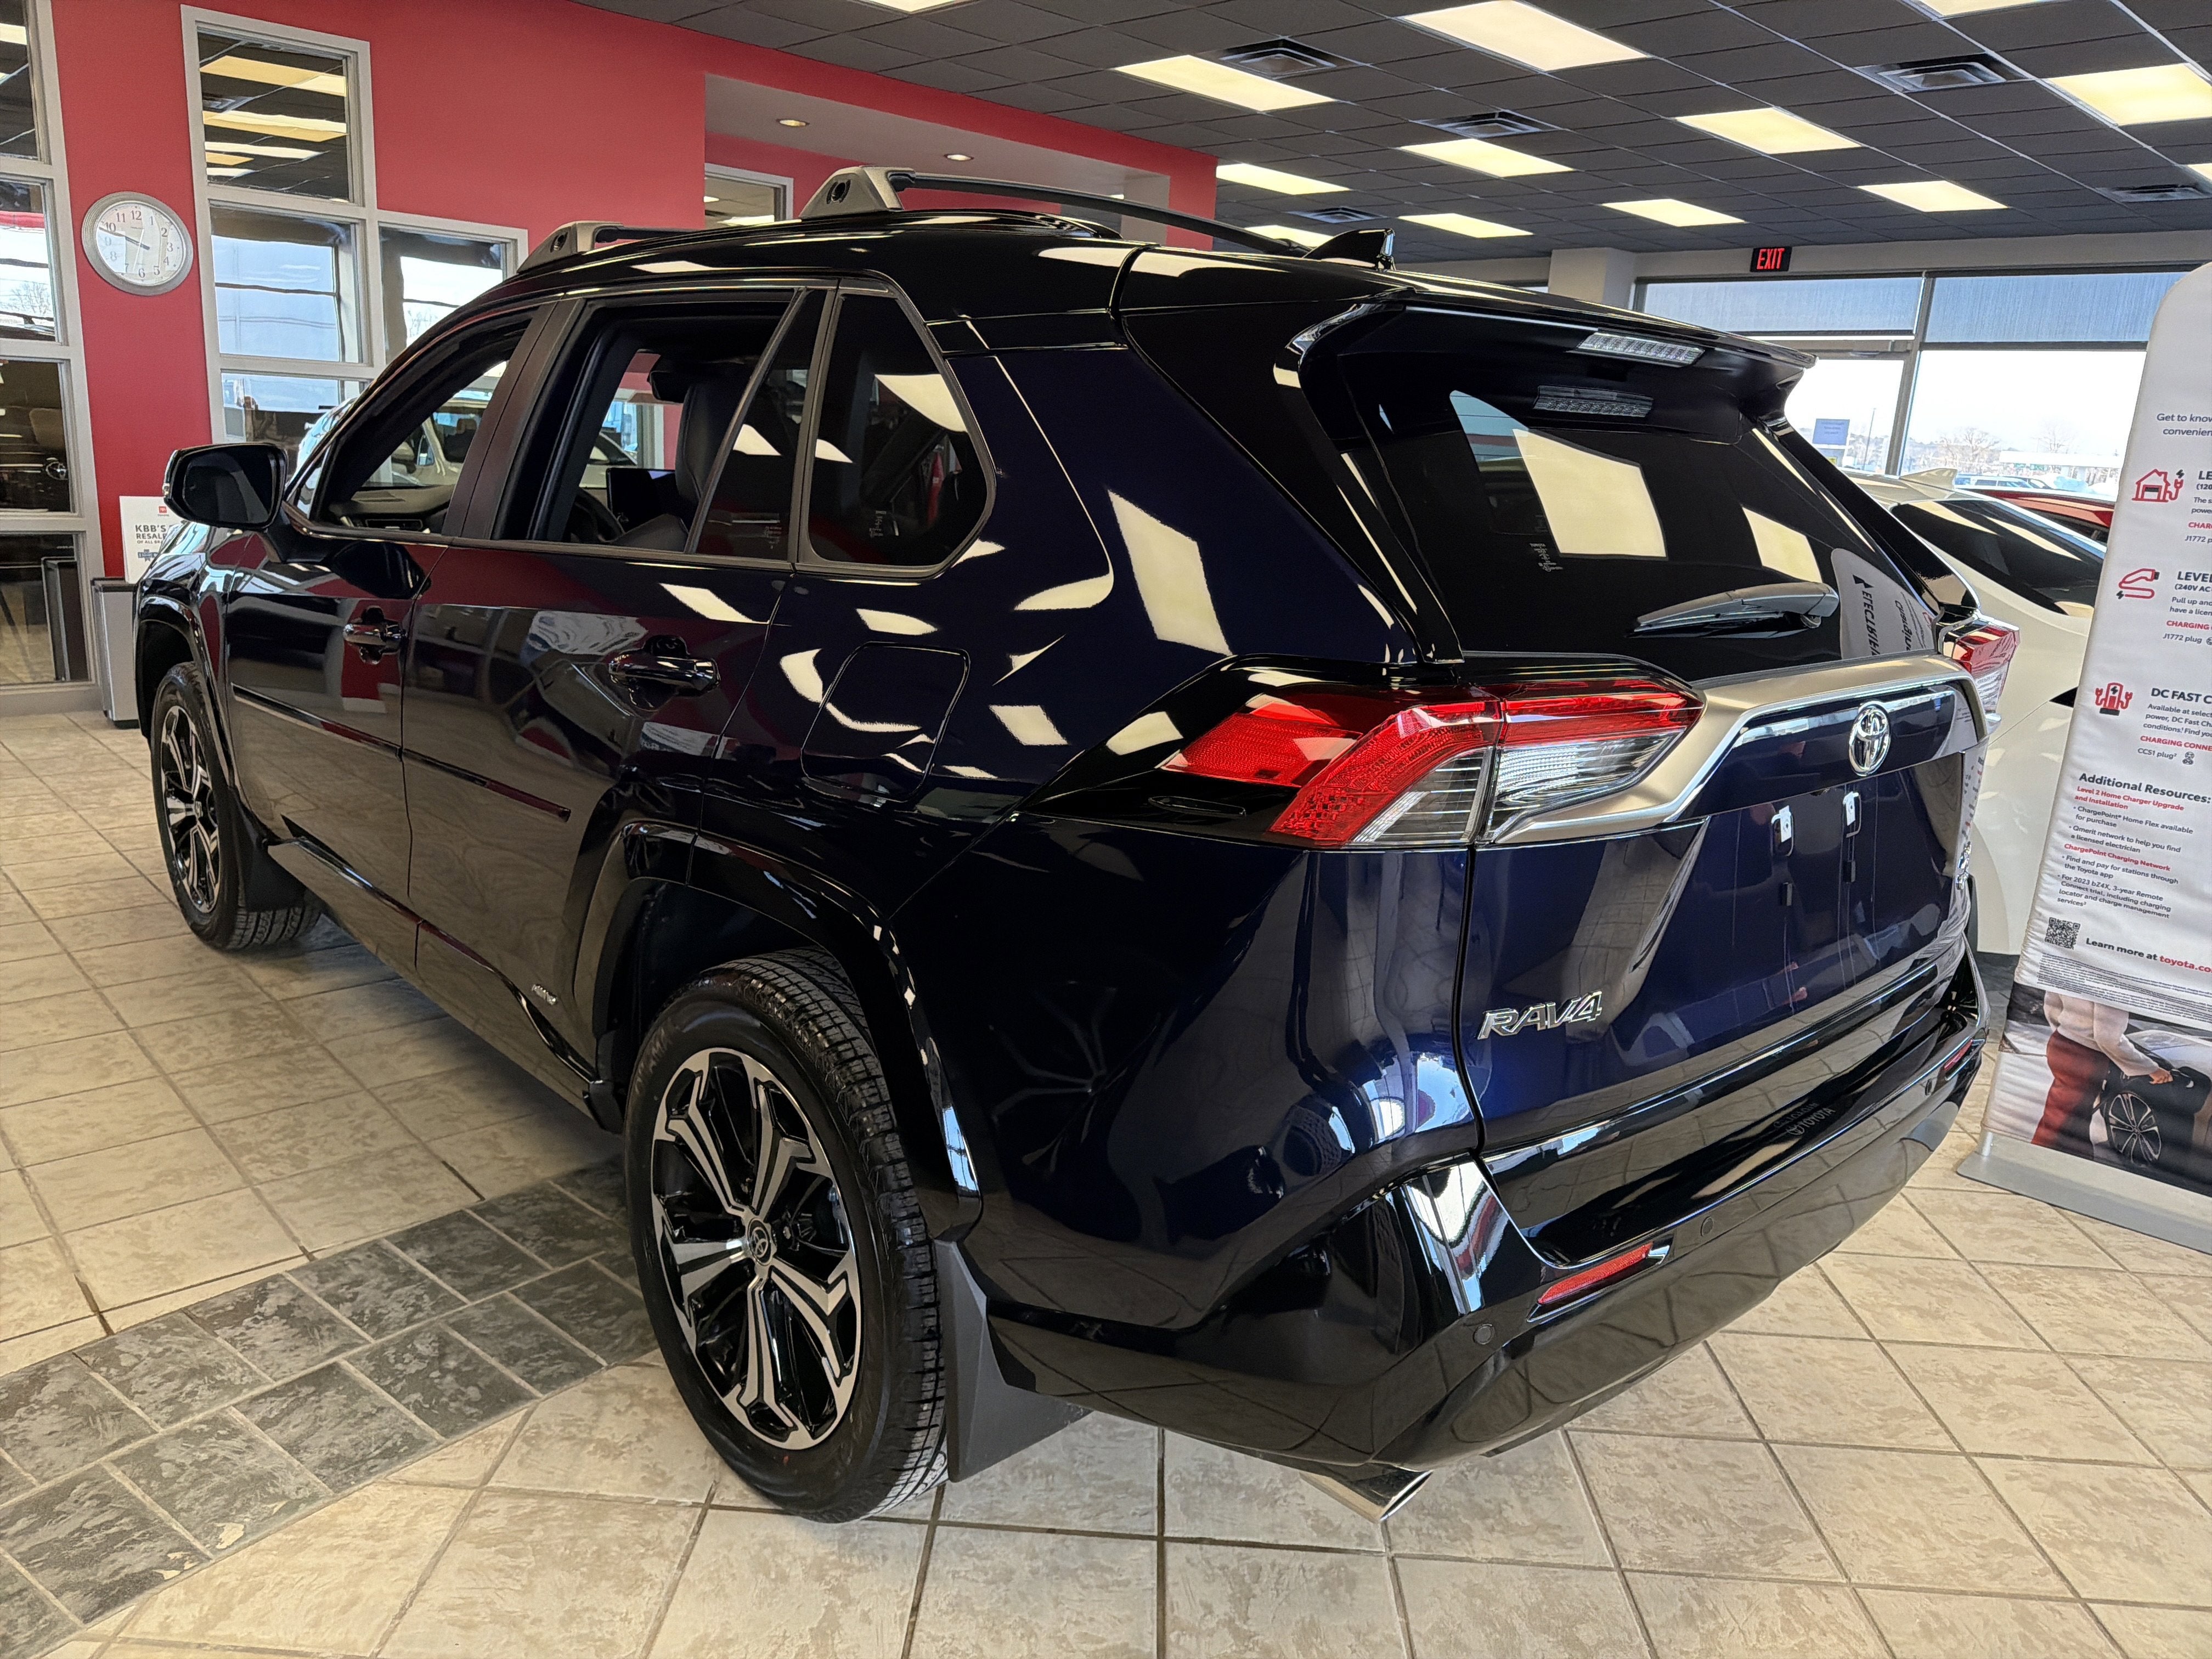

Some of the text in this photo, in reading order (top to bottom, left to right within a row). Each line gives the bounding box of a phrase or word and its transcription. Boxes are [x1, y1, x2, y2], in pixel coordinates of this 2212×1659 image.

[116, 212, 126, 223] 11
[130, 210, 142, 221] 12
[150, 216, 154, 225] 1
[105, 222, 116, 233] 10
[161, 228, 168, 238] 2
[104, 236, 112, 246] 9
[167, 242, 173, 252] 3
[110, 251, 117, 261] 8
[163, 256, 170, 266] 4
[1757, 248, 1785, 269] EXIT
[138, 268, 145, 278] 6
[153, 266, 160, 275] 5
[2157, 413, 2175, 421] Get
[2185, 535, 2206, 543] J1772
[2169, 606, 2187, 614] have
[2166, 620, 2210, 630] CHARGING
[2163, 633, 2203, 644] J1772 plug
[2151, 687, 2170, 698] DC
[2171, 690, 2202, 703] FAST
[2147, 703, 2181, 713] Available
[2145, 713, 2170, 723] power,
[2185, 718, 2199, 726] Fast
[2184, 727, 2200, 736] Find
[2140, 735, 2182, 747] CHARGING
[2137, 748, 2155, 756] CCS1
[2079, 772, 2211, 804] Additional Resources:
[2077, 786, 2095, 794] Level
[2101, 791, 2121, 800] Home
[2123, 795, 2152, 805] Charger
[2152, 800, 2185, 811] Upgrade
[2089, 797, 2129, 810] Installation
[2086, 817, 2117, 828] purchase
[2123, 815, 2144, 825] Home
[2145, 820, 2160, 828] Flex
[2160, 823, 2194, 834] available
[2073, 825, 2097, 836] Qmerit
[2097, 831, 2126, 841] network
[2135, 838, 2151, 847] help
[2166, 844, 2181, 853] find
[2076, 834, 2104, 845] licensed
[2105, 841, 2141, 853] electrician
[2064, 843, 2171, 871] ChargePoint Charging Network
[2066, 855, 2081, 863] Find
[2121, 867, 2149, 877] stations
[2151, 873, 2179, 884] through
[2077, 866, 2098, 876] Toyota
[2073, 877, 2090, 885] 2023
[2113, 885, 2135, 894] 3-year
[2136, 890, 2164, 901] Remote
[2061, 881, 2089, 892] Connect
[2106, 892, 2139, 905] including
[2140, 900, 2171, 912] charging
[2059, 888, 2084, 898] locator
[2098, 898, 2122, 907] charge
[2123, 903, 2170, 918] management
[2086, 938, 2114, 951] Learn
[2117, 946, 2145, 958] more
[2159, 955, 2212, 973] toyota.co
[1476, 989, 1602, 1040] RAV4
[1802, 1107, 1836, 1128] TOYOTA
